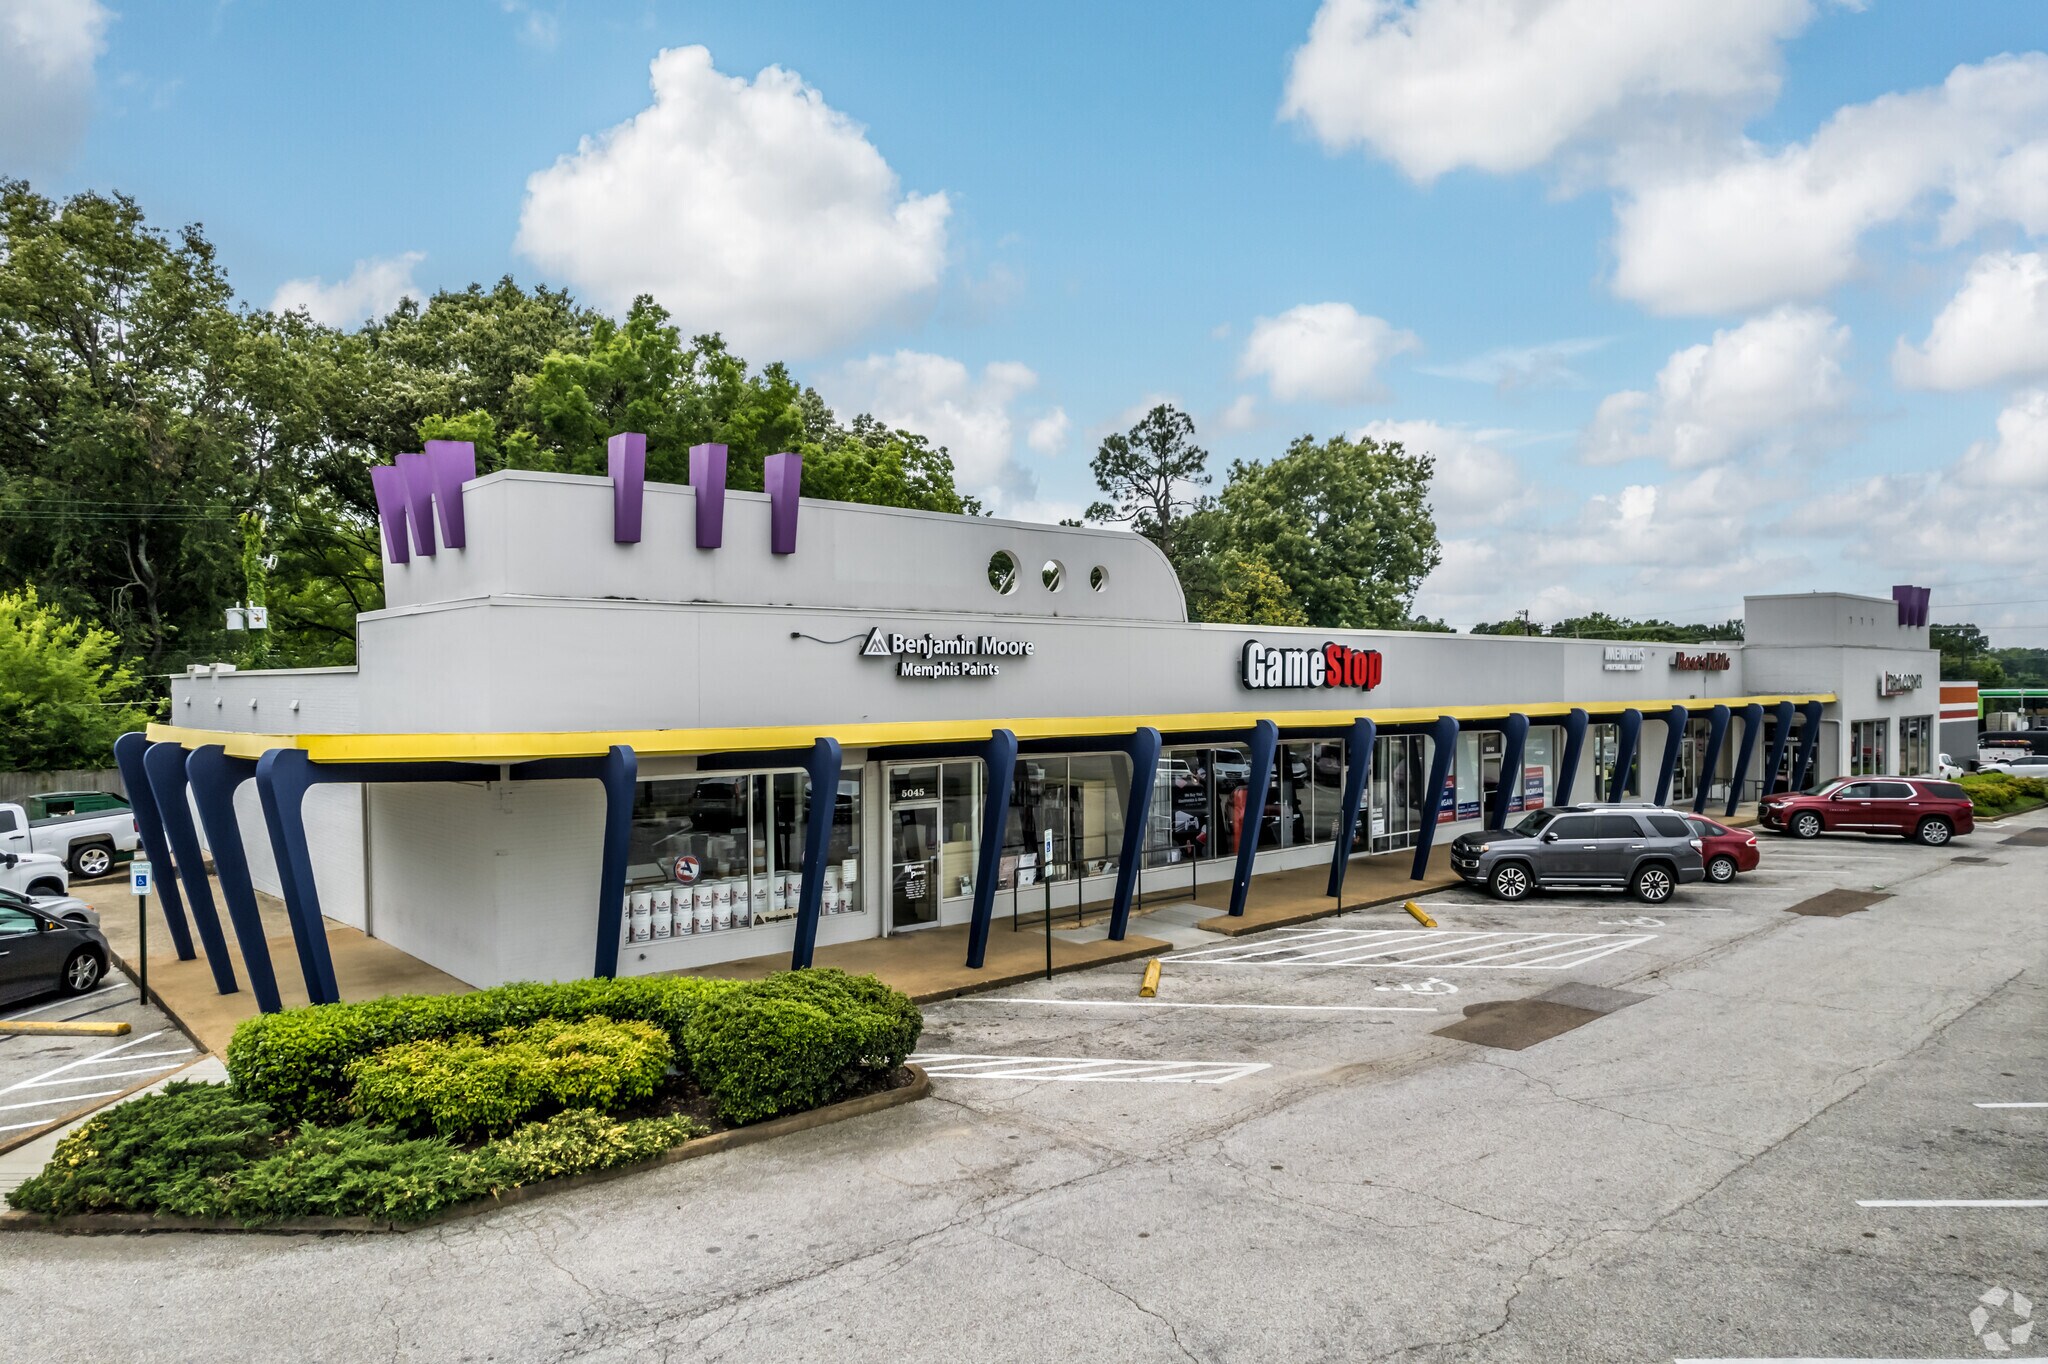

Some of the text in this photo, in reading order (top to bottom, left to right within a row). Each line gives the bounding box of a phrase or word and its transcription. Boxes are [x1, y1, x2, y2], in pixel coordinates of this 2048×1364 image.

[891, 633, 1035, 659] Benjamin Moore
[1605, 646, 1646, 661] MEMPHIS
[901, 661, 1000, 679] Memphis Paints
[1246, 641, 1382, 689] GameStop
[901, 788, 925, 798] 5045
[1525, 787, 1543, 796] MORGAN
[765, 913, 792, 923] Benjamin
